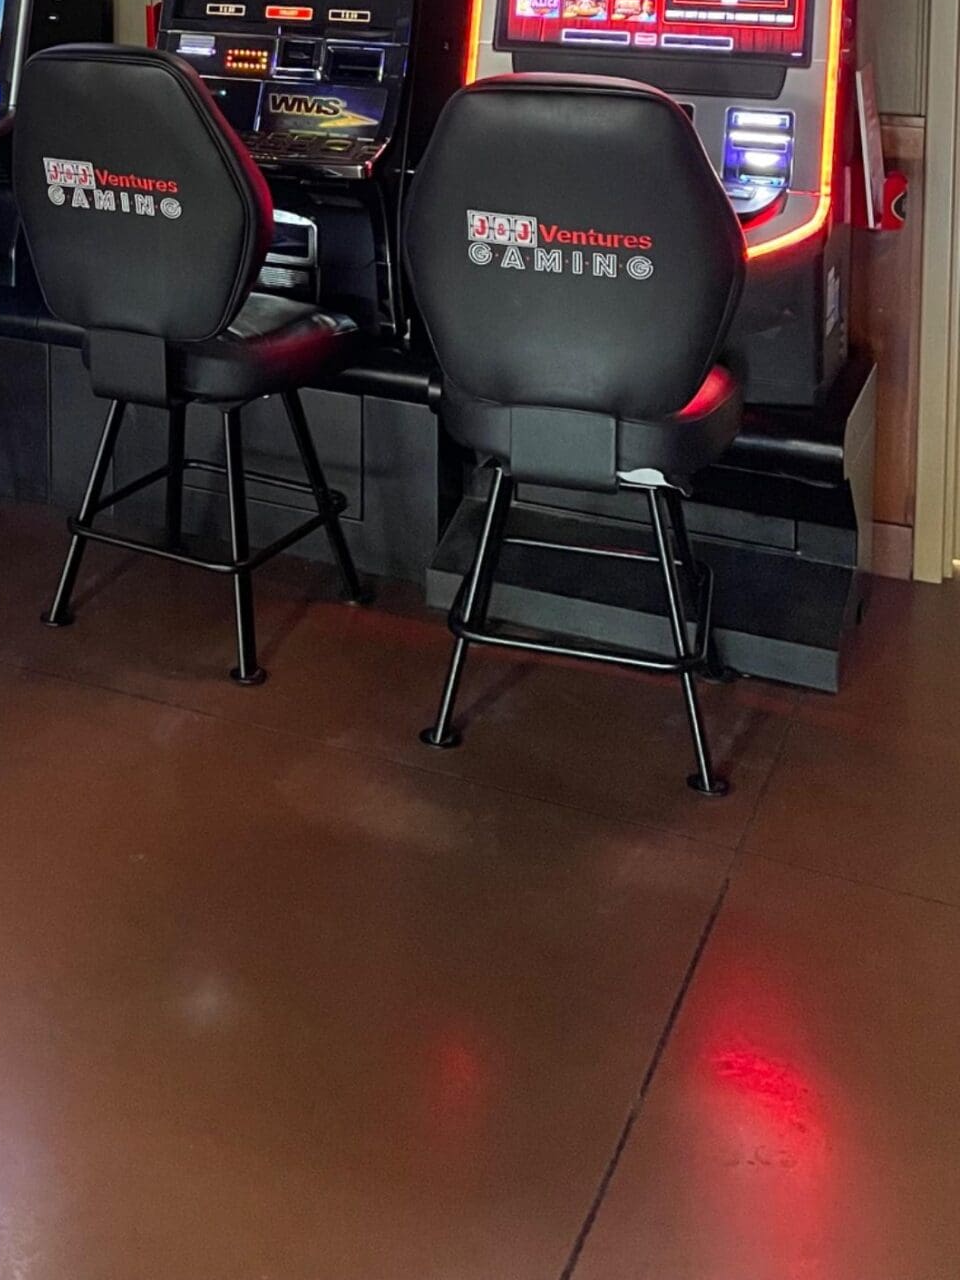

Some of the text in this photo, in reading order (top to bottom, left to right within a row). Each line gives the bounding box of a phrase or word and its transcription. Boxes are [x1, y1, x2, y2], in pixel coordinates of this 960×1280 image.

[269, 93, 347, 117] WMS
[95, 169, 179, 193] Ventures
[47, 183, 183, 220] GAMING
[539, 223, 653, 250] Ventures
[467, 241, 654, 281] GAMING
